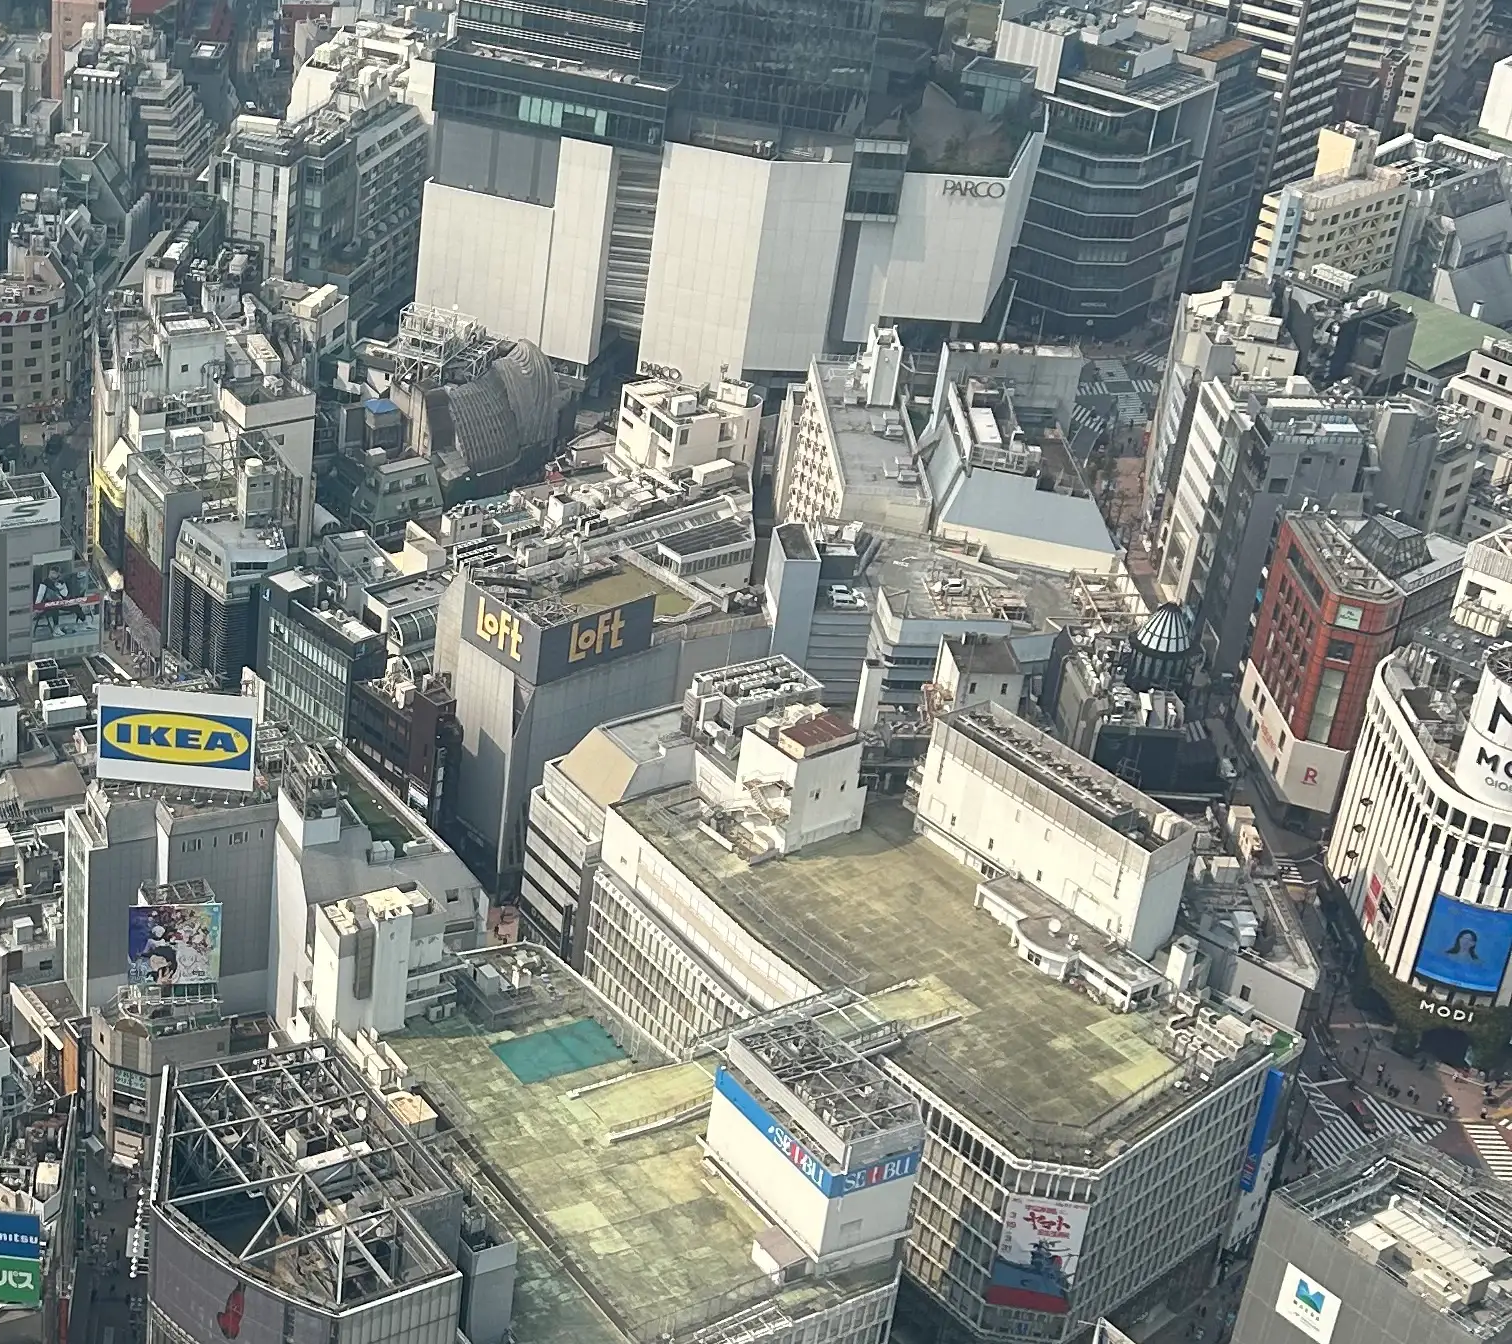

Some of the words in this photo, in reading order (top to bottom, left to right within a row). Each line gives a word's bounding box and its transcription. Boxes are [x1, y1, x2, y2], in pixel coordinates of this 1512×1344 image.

[942, 179, 1005, 199] PARCO
[639, 360, 683, 382] PARCO
[116, 723, 239, 753] IKEA
[1418, 999, 1474, 1024] MODI
[772, 1126, 824, 1189] SEIBU
[843, 1156, 911, 1192] SEIBU
